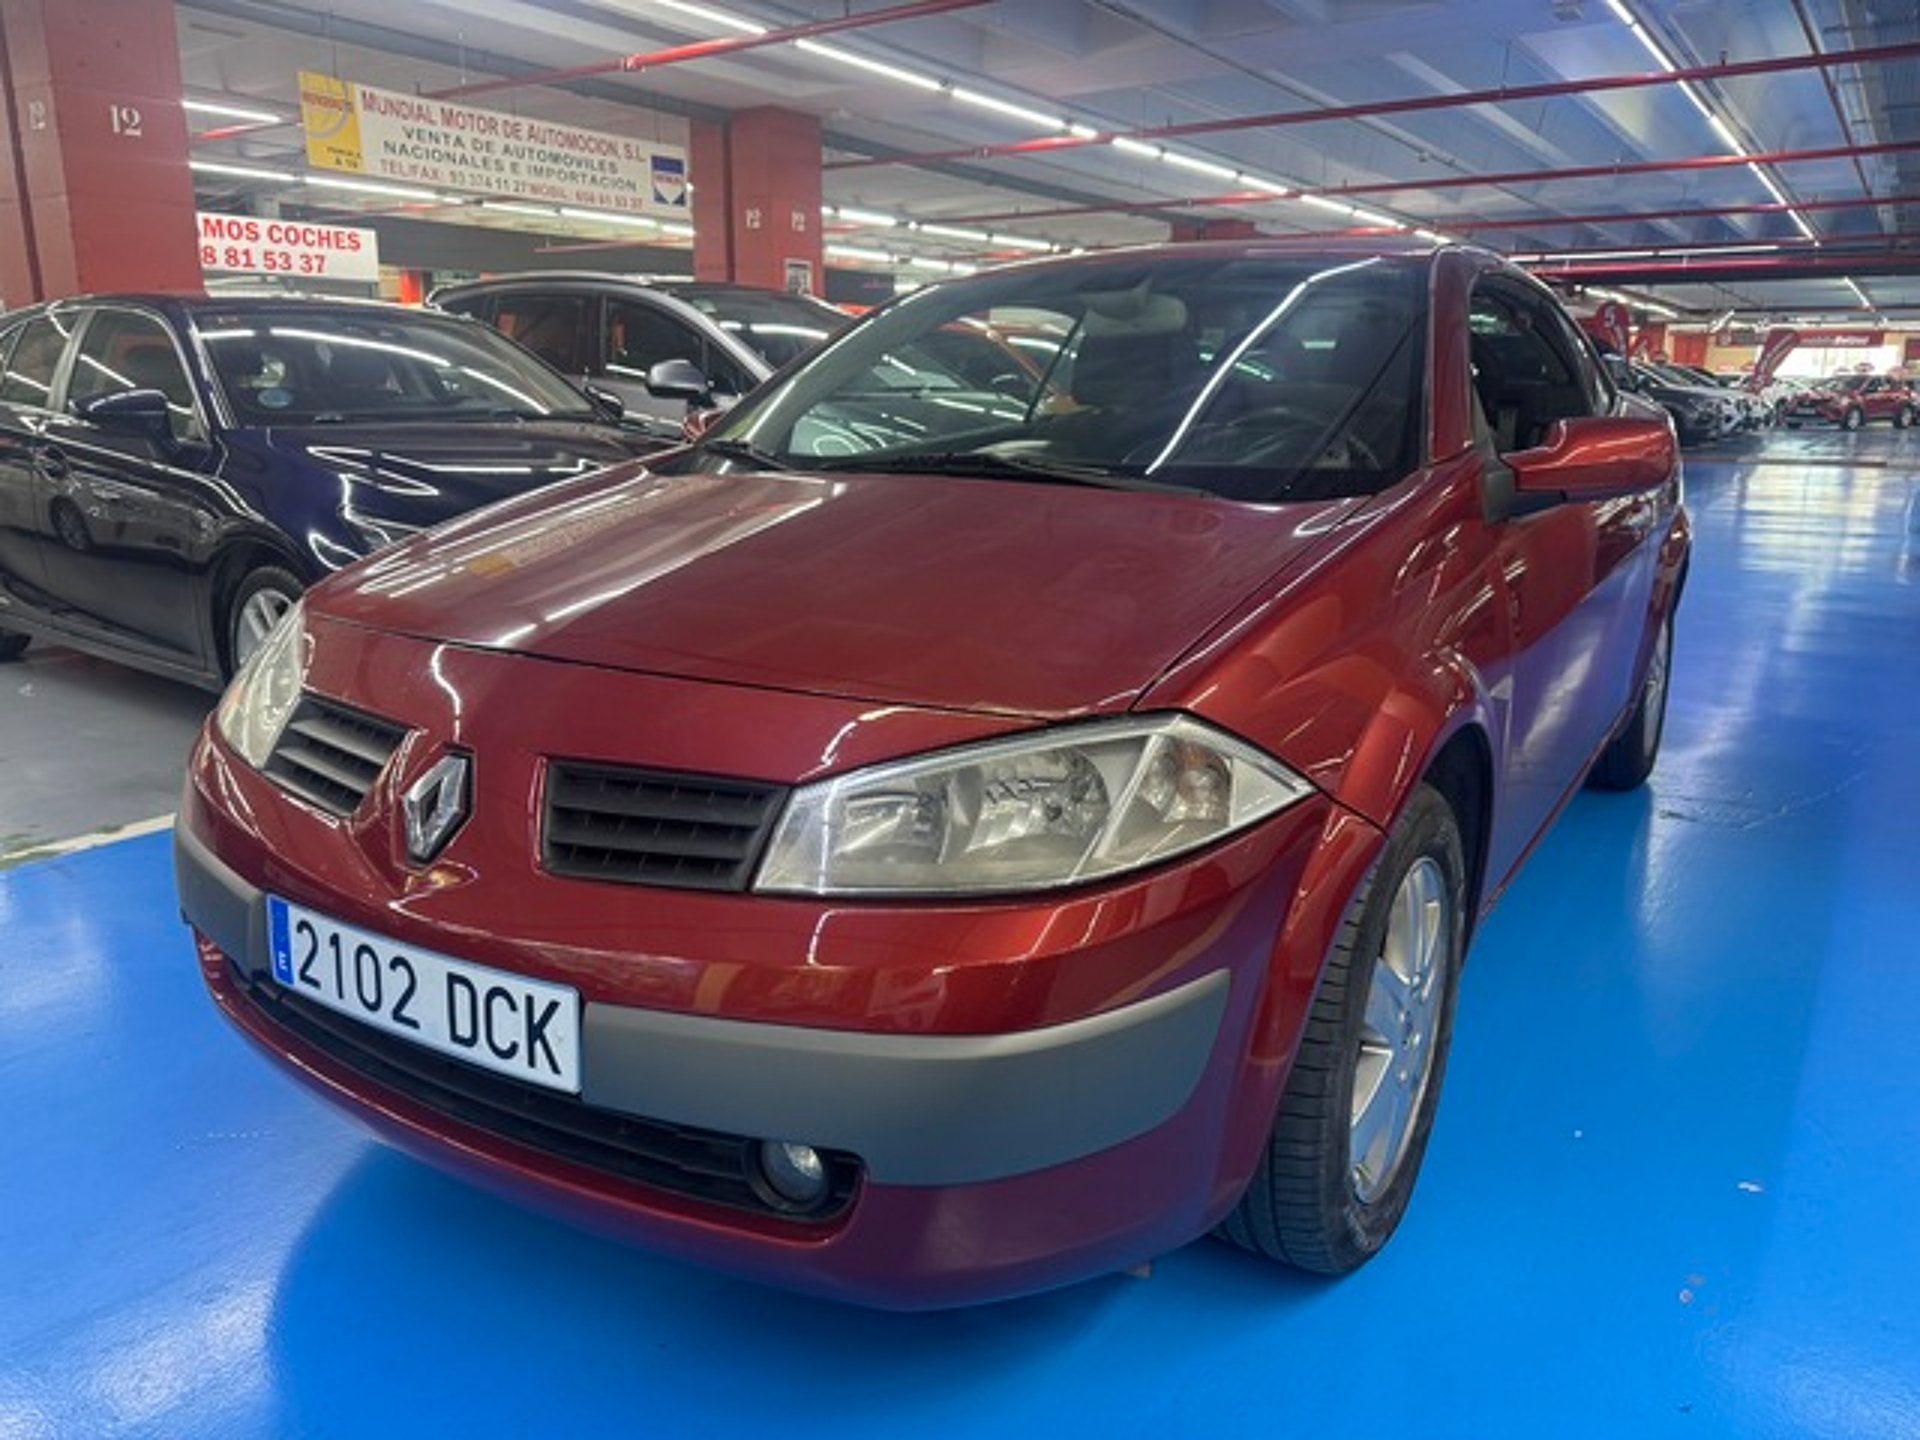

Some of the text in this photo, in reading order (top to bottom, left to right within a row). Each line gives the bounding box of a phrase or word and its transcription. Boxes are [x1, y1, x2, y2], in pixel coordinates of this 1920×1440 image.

[109, 104, 142, 137] 12
[361, 89, 438, 125] MUNDIAL
[440, 107, 499, 135] MOTOR
[502, 119, 523, 141] DE
[383, 140, 505, 172] NACIONALES
[510, 161, 523, 174] E
[402, 125, 619, 175] VENTA DE AUTOMOVILES
[199, 218, 362, 251] MOS COCHES
[224, 246, 256, 268] 81
[263, 250, 292, 272] 53
[300, 254, 326, 274] 37
[296, 919, 562, 1076] 2102 DCK
